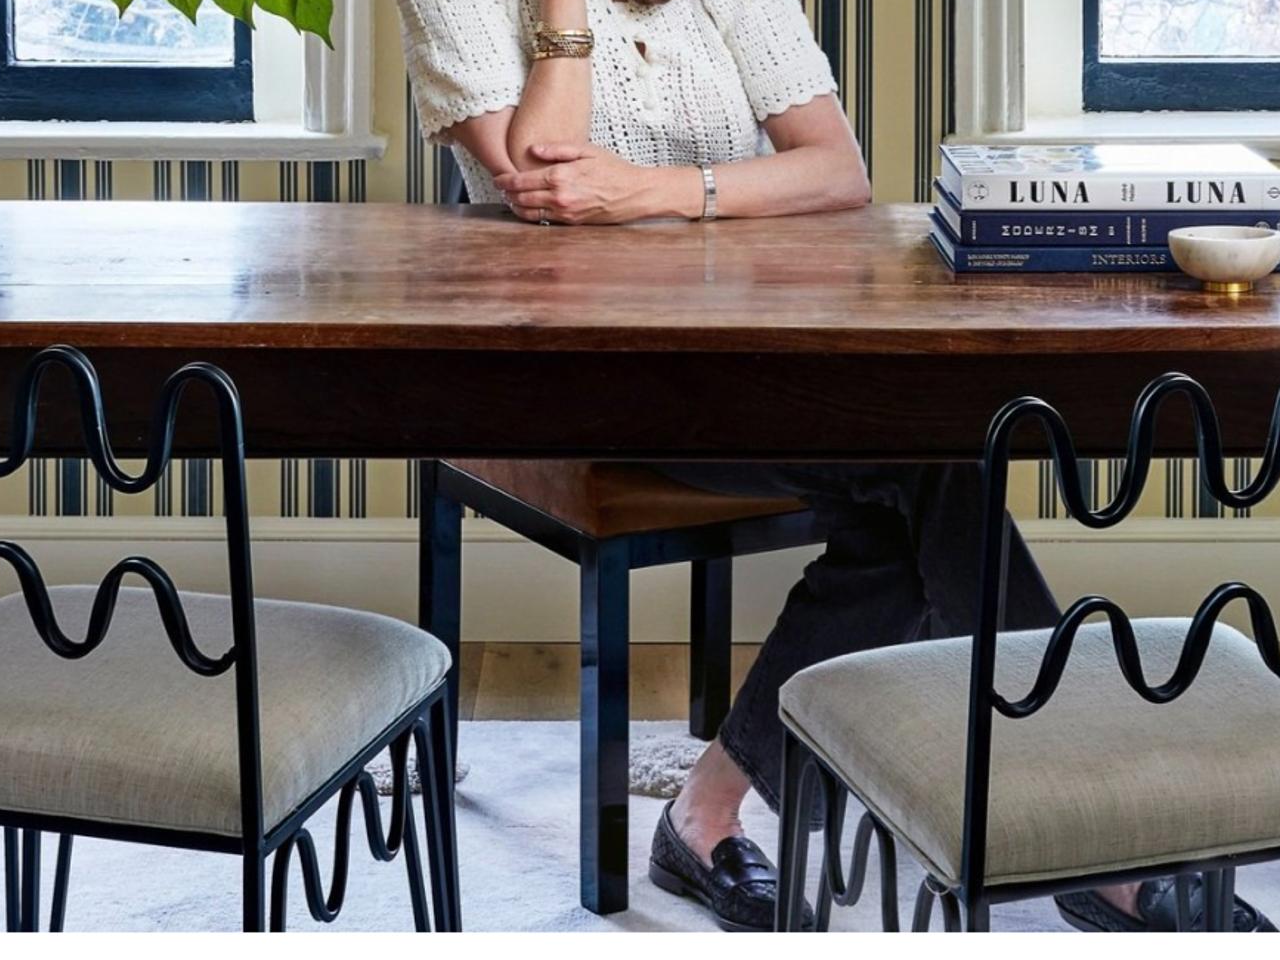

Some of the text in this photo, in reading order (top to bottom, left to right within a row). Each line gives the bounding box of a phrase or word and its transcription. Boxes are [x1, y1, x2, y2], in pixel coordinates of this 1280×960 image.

[1009, 181, 1090, 203] LUNA
[1166, 181, 1246, 203] LUNA
[1001, 225, 1099, 237] MODERNISM
[1091, 254, 1167, 265] INTERIORS
